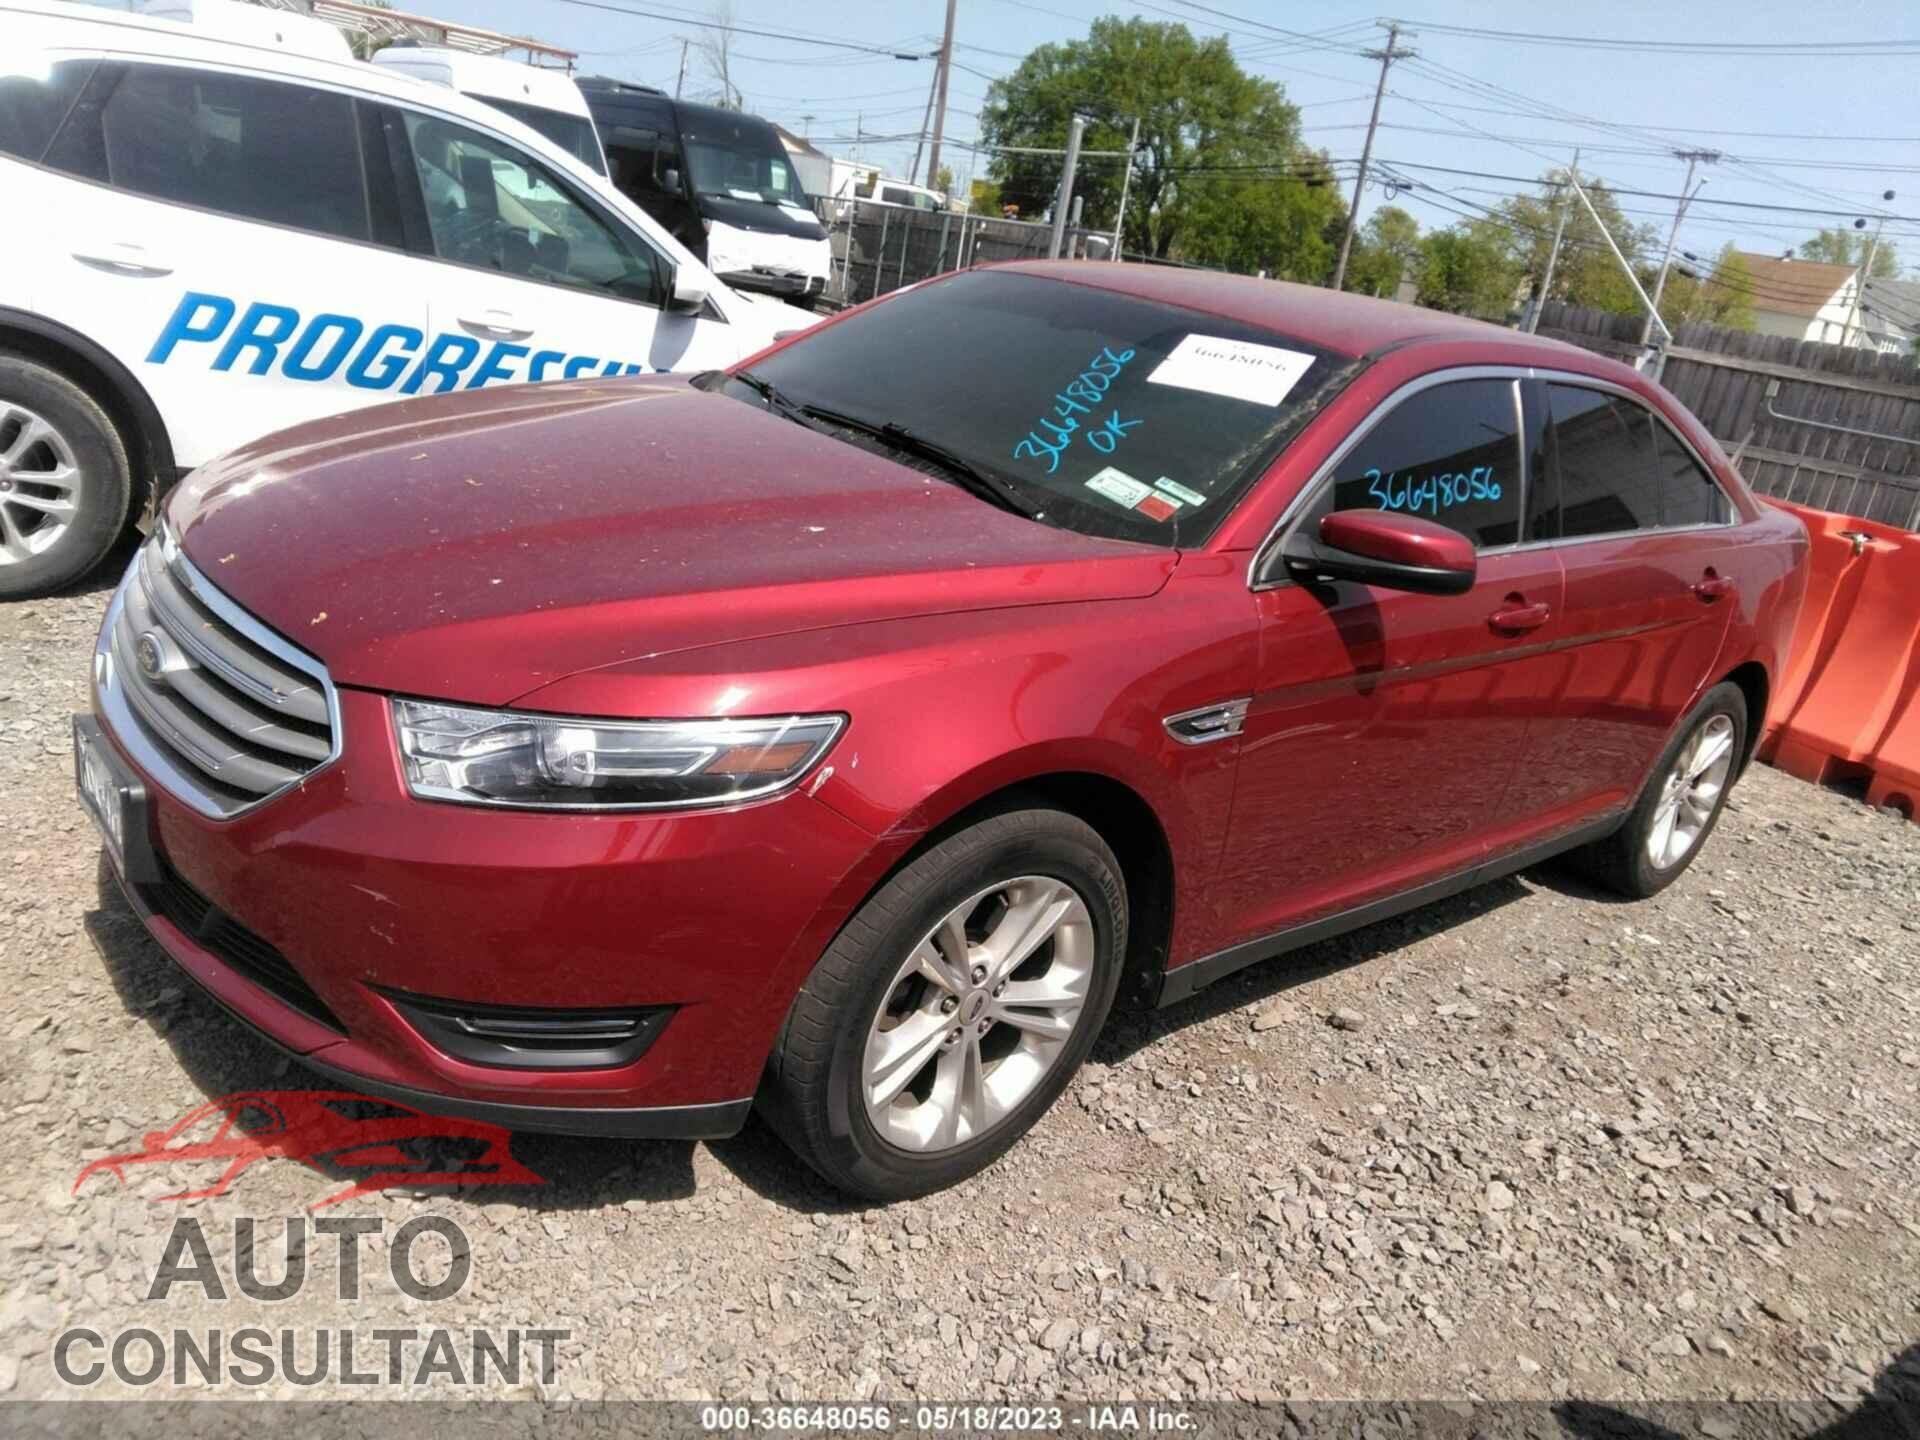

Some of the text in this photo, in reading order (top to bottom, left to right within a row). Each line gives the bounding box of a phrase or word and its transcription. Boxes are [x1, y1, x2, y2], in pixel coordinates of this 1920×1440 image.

[144, 291, 672, 395] PROGRE
[1013, 346, 1136, 474] 36648056
[1087, 409, 1144, 453] OK
[1364, 466, 1502, 515] 36648056
